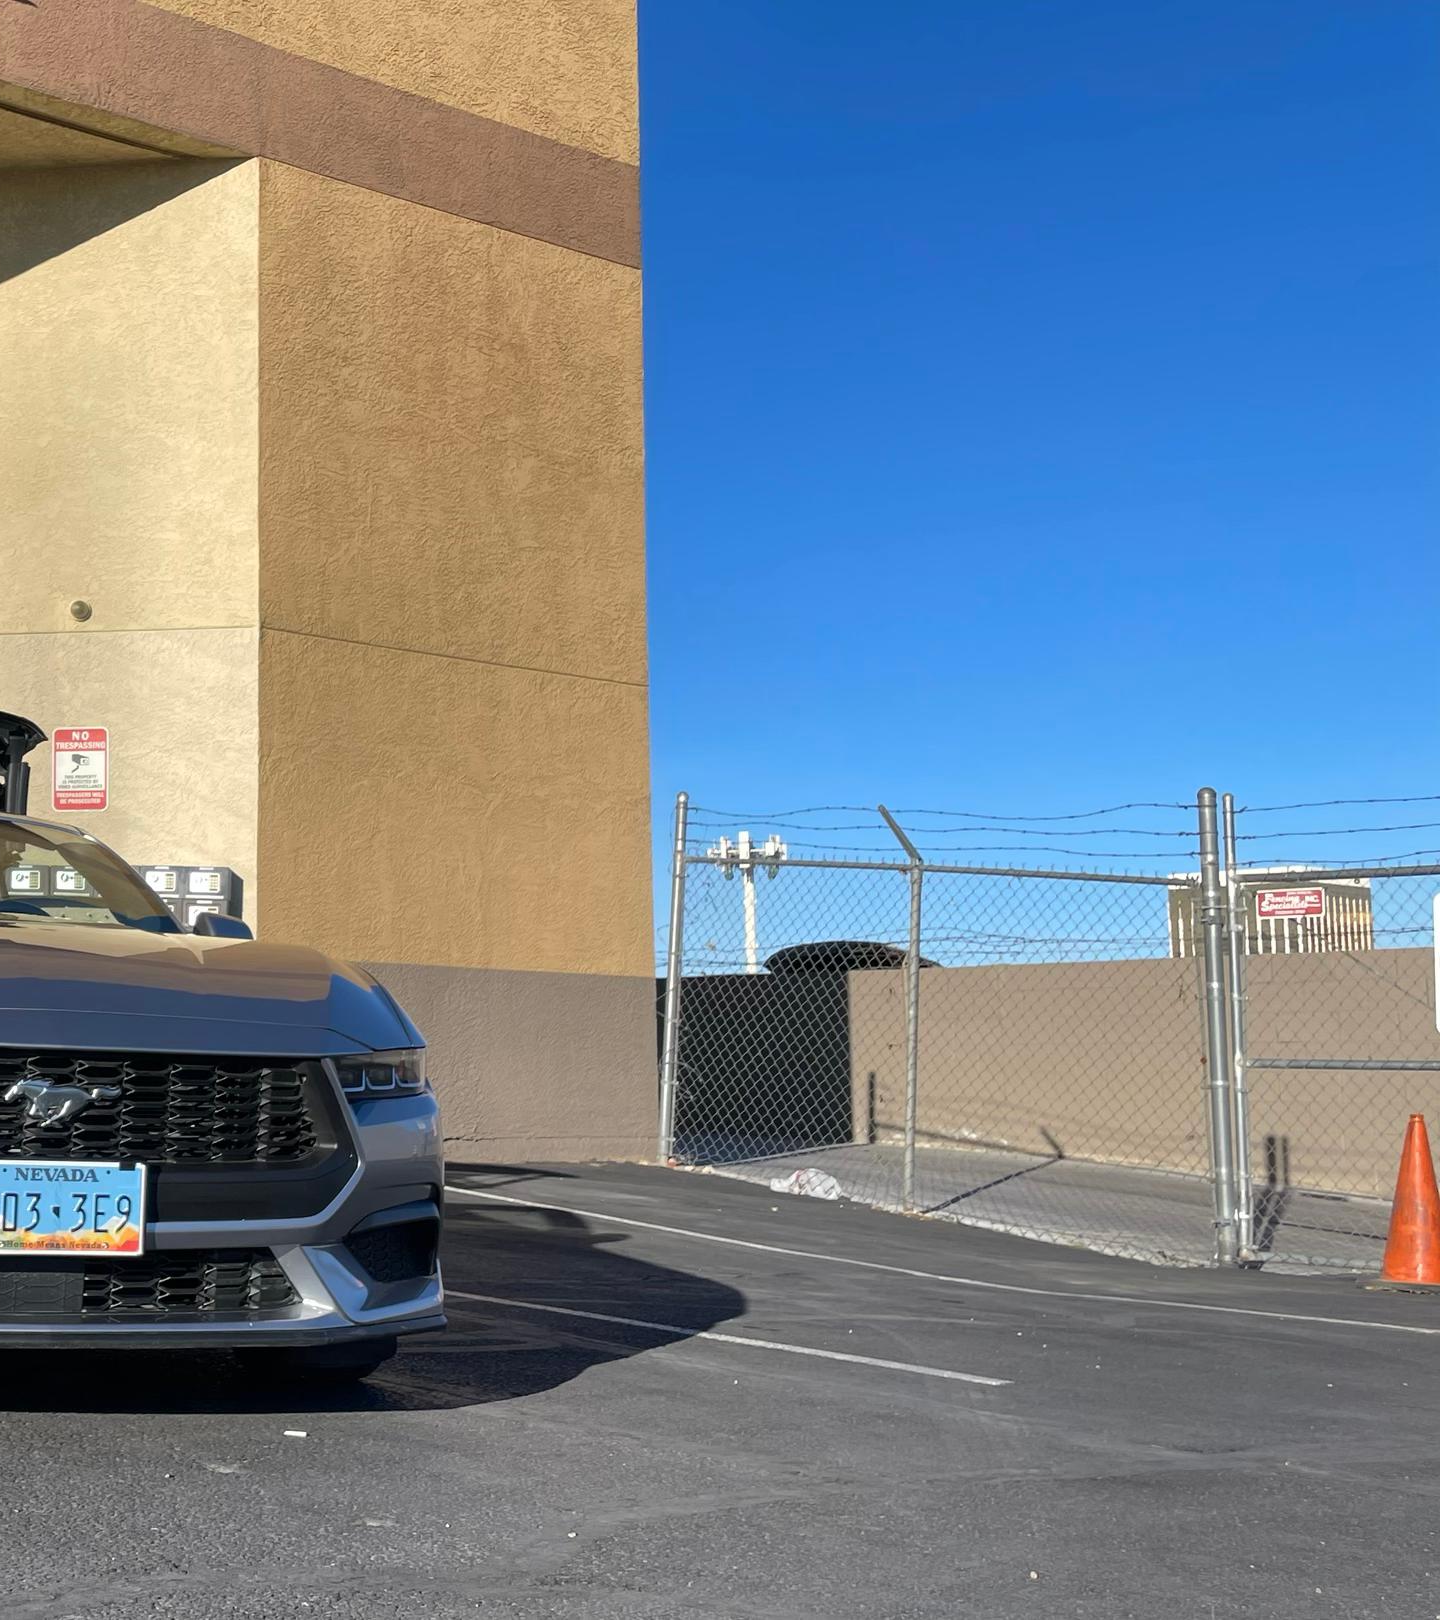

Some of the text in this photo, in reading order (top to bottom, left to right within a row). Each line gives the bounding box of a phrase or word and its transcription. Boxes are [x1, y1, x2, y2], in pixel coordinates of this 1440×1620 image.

[71, 731, 90, 741] NO
[55, 742, 105, 750] TRESPASSING
[14, 1167, 99, 1182] NEVADA
[71, 1193, 131, 1233] 3E9
